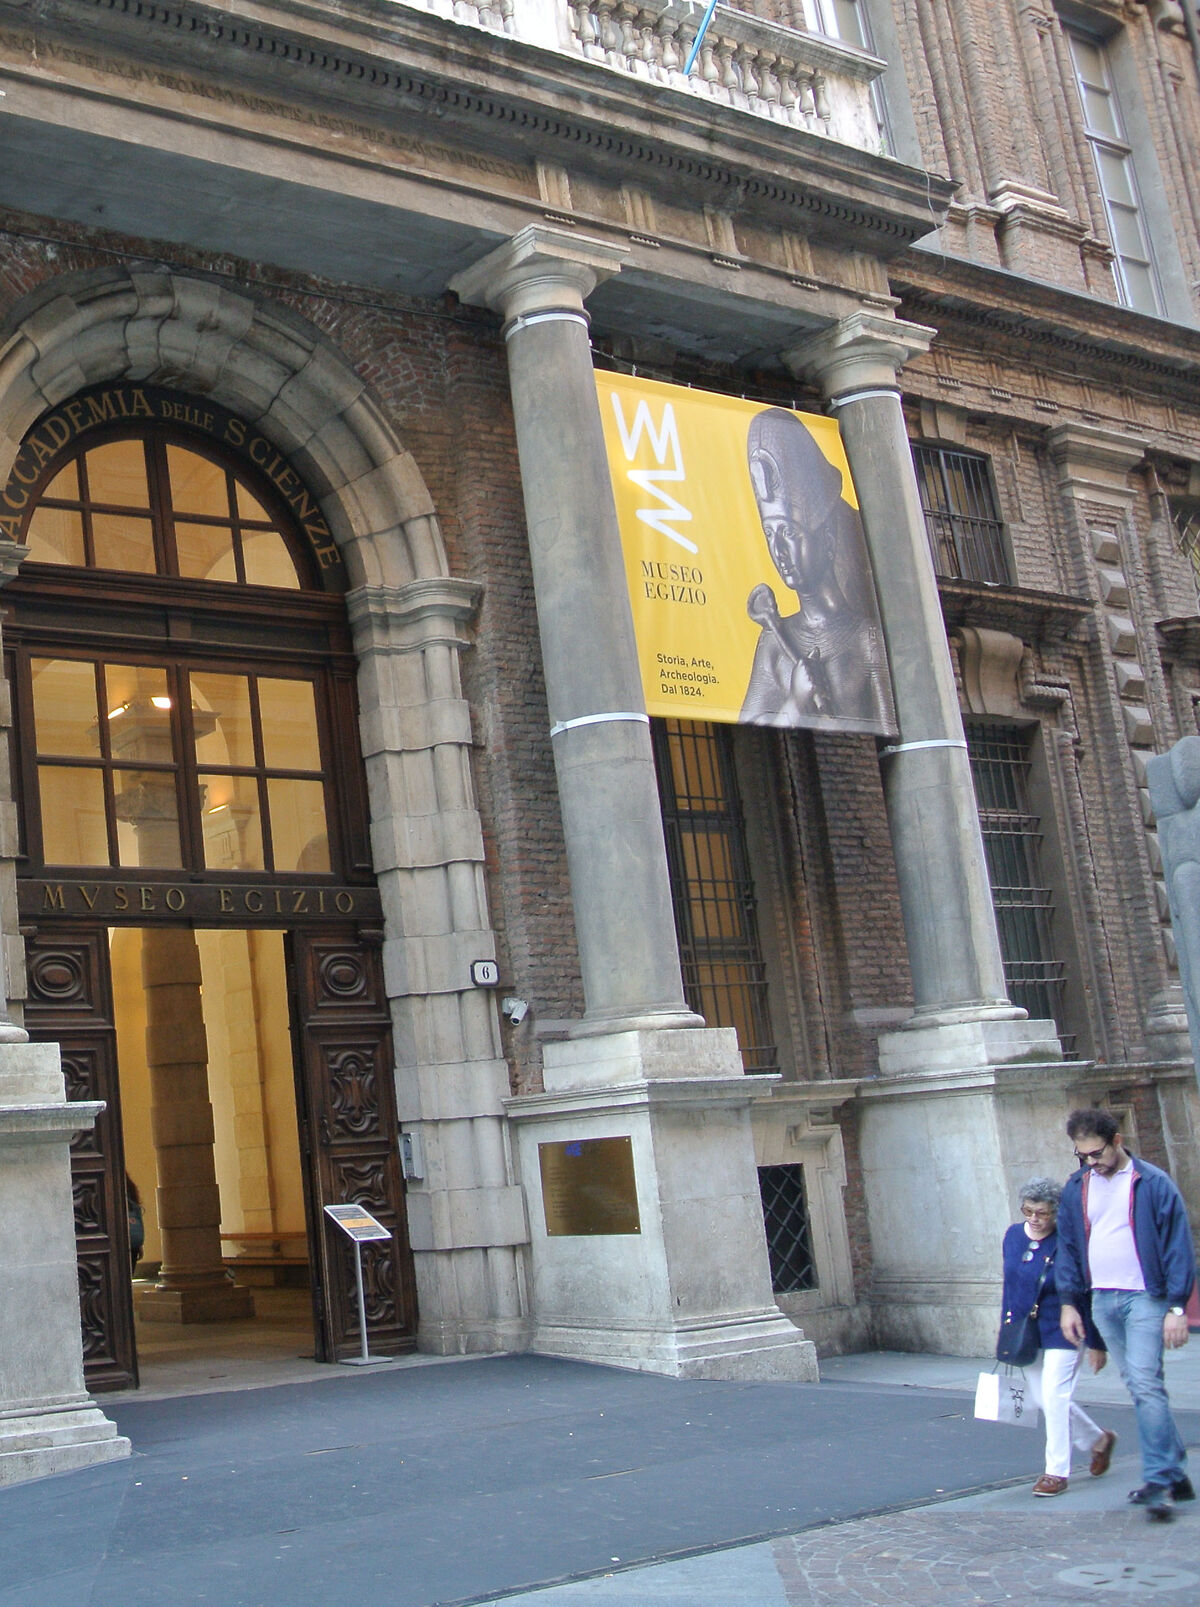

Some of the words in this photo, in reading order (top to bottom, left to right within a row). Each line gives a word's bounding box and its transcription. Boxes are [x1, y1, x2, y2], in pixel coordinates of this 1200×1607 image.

[161, 401, 214, 431] DELLE
[223, 418, 342, 570] SCIENZE
[640, 560, 703, 585] MUSEO
[645, 582, 707, 606] EGIZIO
[657, 653, 690, 669] Storia,
[691, 657, 715, 670] Arte,
[660, 668, 720, 685] Archeologia.
[661, 683, 677, 695] Dal
[678, 685, 705, 698] 1824.
[42, 884, 186, 912] MVSEO
[219, 888, 355, 914] EGIZIO
[482, 965, 490, 980] 6
